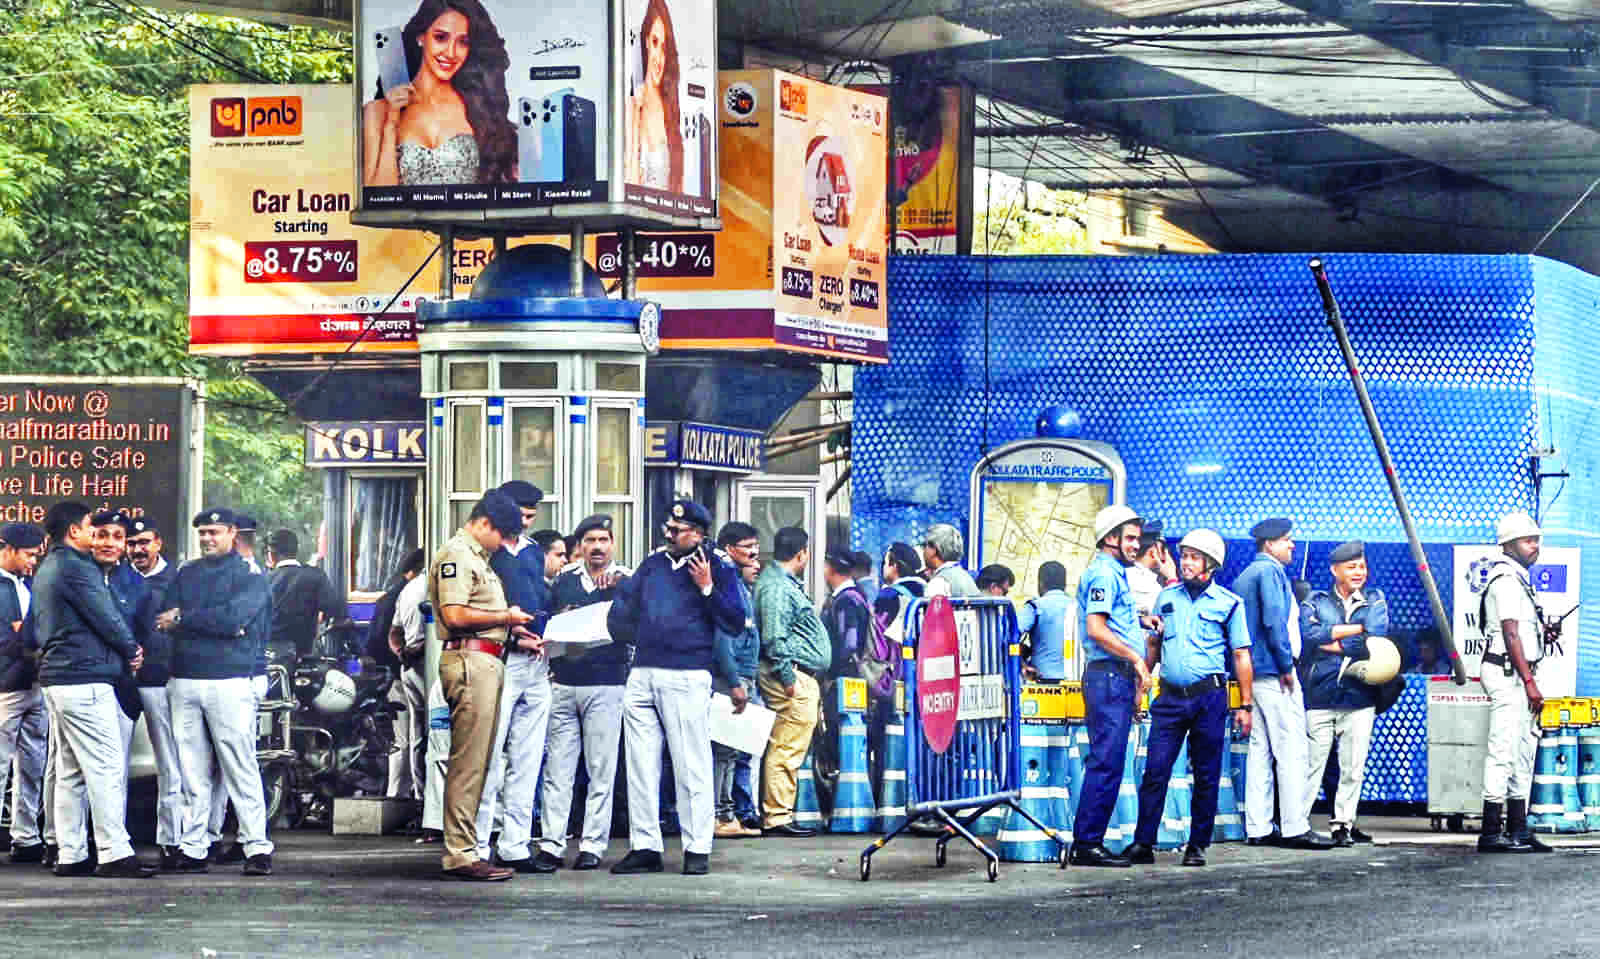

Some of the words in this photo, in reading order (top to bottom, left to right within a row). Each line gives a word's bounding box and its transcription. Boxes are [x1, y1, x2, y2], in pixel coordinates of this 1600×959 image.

[251, 99, 297, 133] pnb
[252, 189, 290, 213] Car
[297, 188, 351, 213] Loan
[274, 219, 328, 235] Starting
[819, 275, 843, 296] ZERO
[25, 390, 75, 412] Now
[83, 389, 109, 418] @
[11, 445, 83, 468] Police
[92, 445, 145, 469] Safe
[682, 428, 725, 463] KOLKATA
[727, 434, 761, 468] POLICE
[1072, 465, 1105, 478] POLICE
[31, 472, 73, 496] Life
[82, 472, 128, 497] Half
